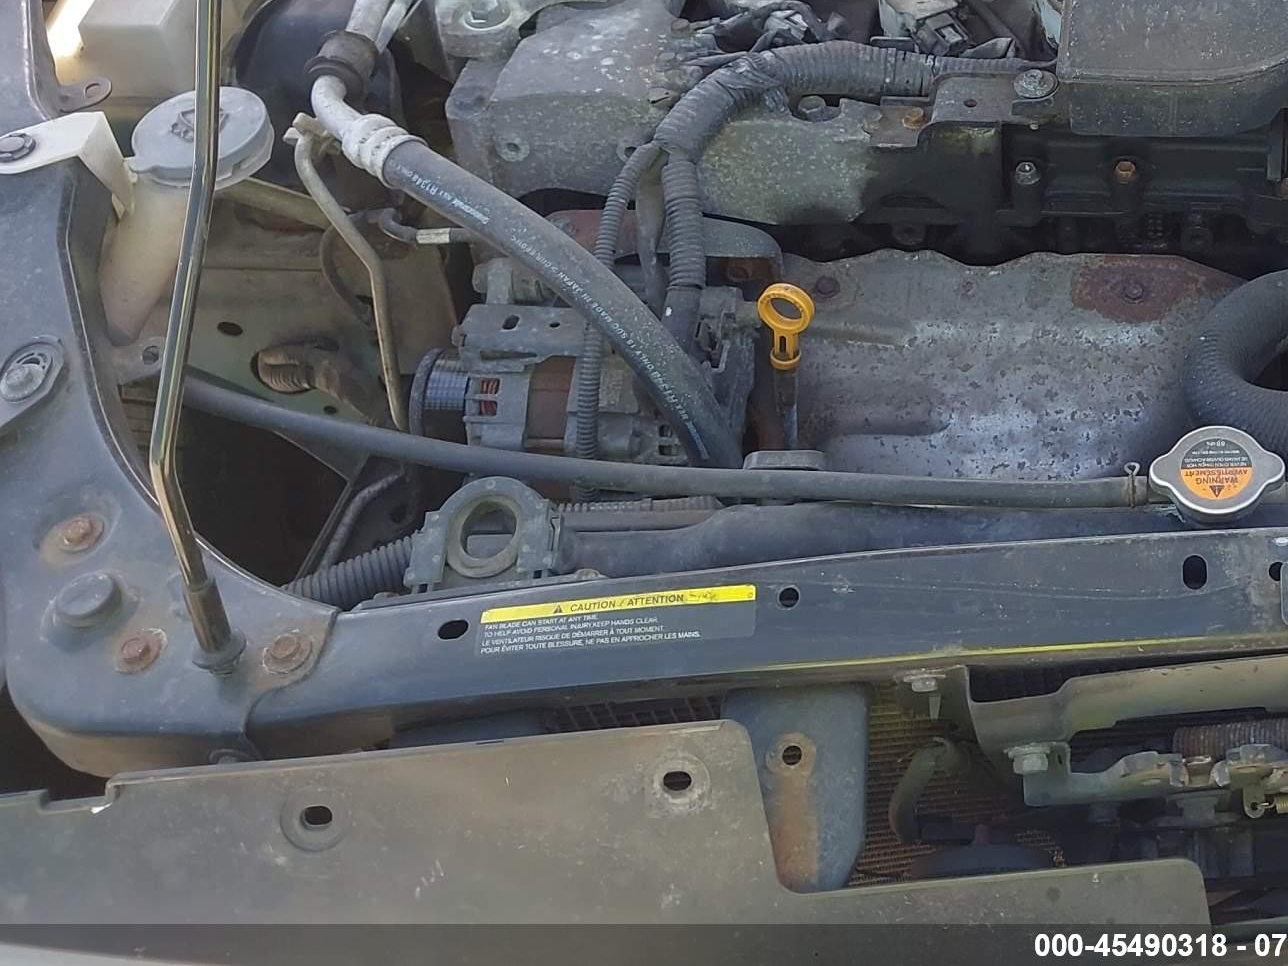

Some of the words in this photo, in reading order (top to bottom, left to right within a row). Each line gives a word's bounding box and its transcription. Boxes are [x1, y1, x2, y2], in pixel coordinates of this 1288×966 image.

[559, 272, 583, 293] JAPAN
[591, 302, 613, 323] MADE
[635, 350, 654, 370] ONLY
[1184, 468, 1248, 477] AVERTISSEMENT
[1196, 476, 1239, 485] WARNING
[570, 599, 616, 612] CAUTION
[627, 594, 684, 607] ATTENTION
[534, 625, 569, 634] PERSONAL
[610, 618, 635, 626] HANDS
[491, 636, 534, 645] VENTILATEUR
[535, 634, 561, 642] RISQUE
[571, 629, 608, 638] DÉMARRER
[500, 644, 524, 653] ÉVITER
[621, 634, 664, 643] APPROCHER
[664, 632, 677, 640] LES
